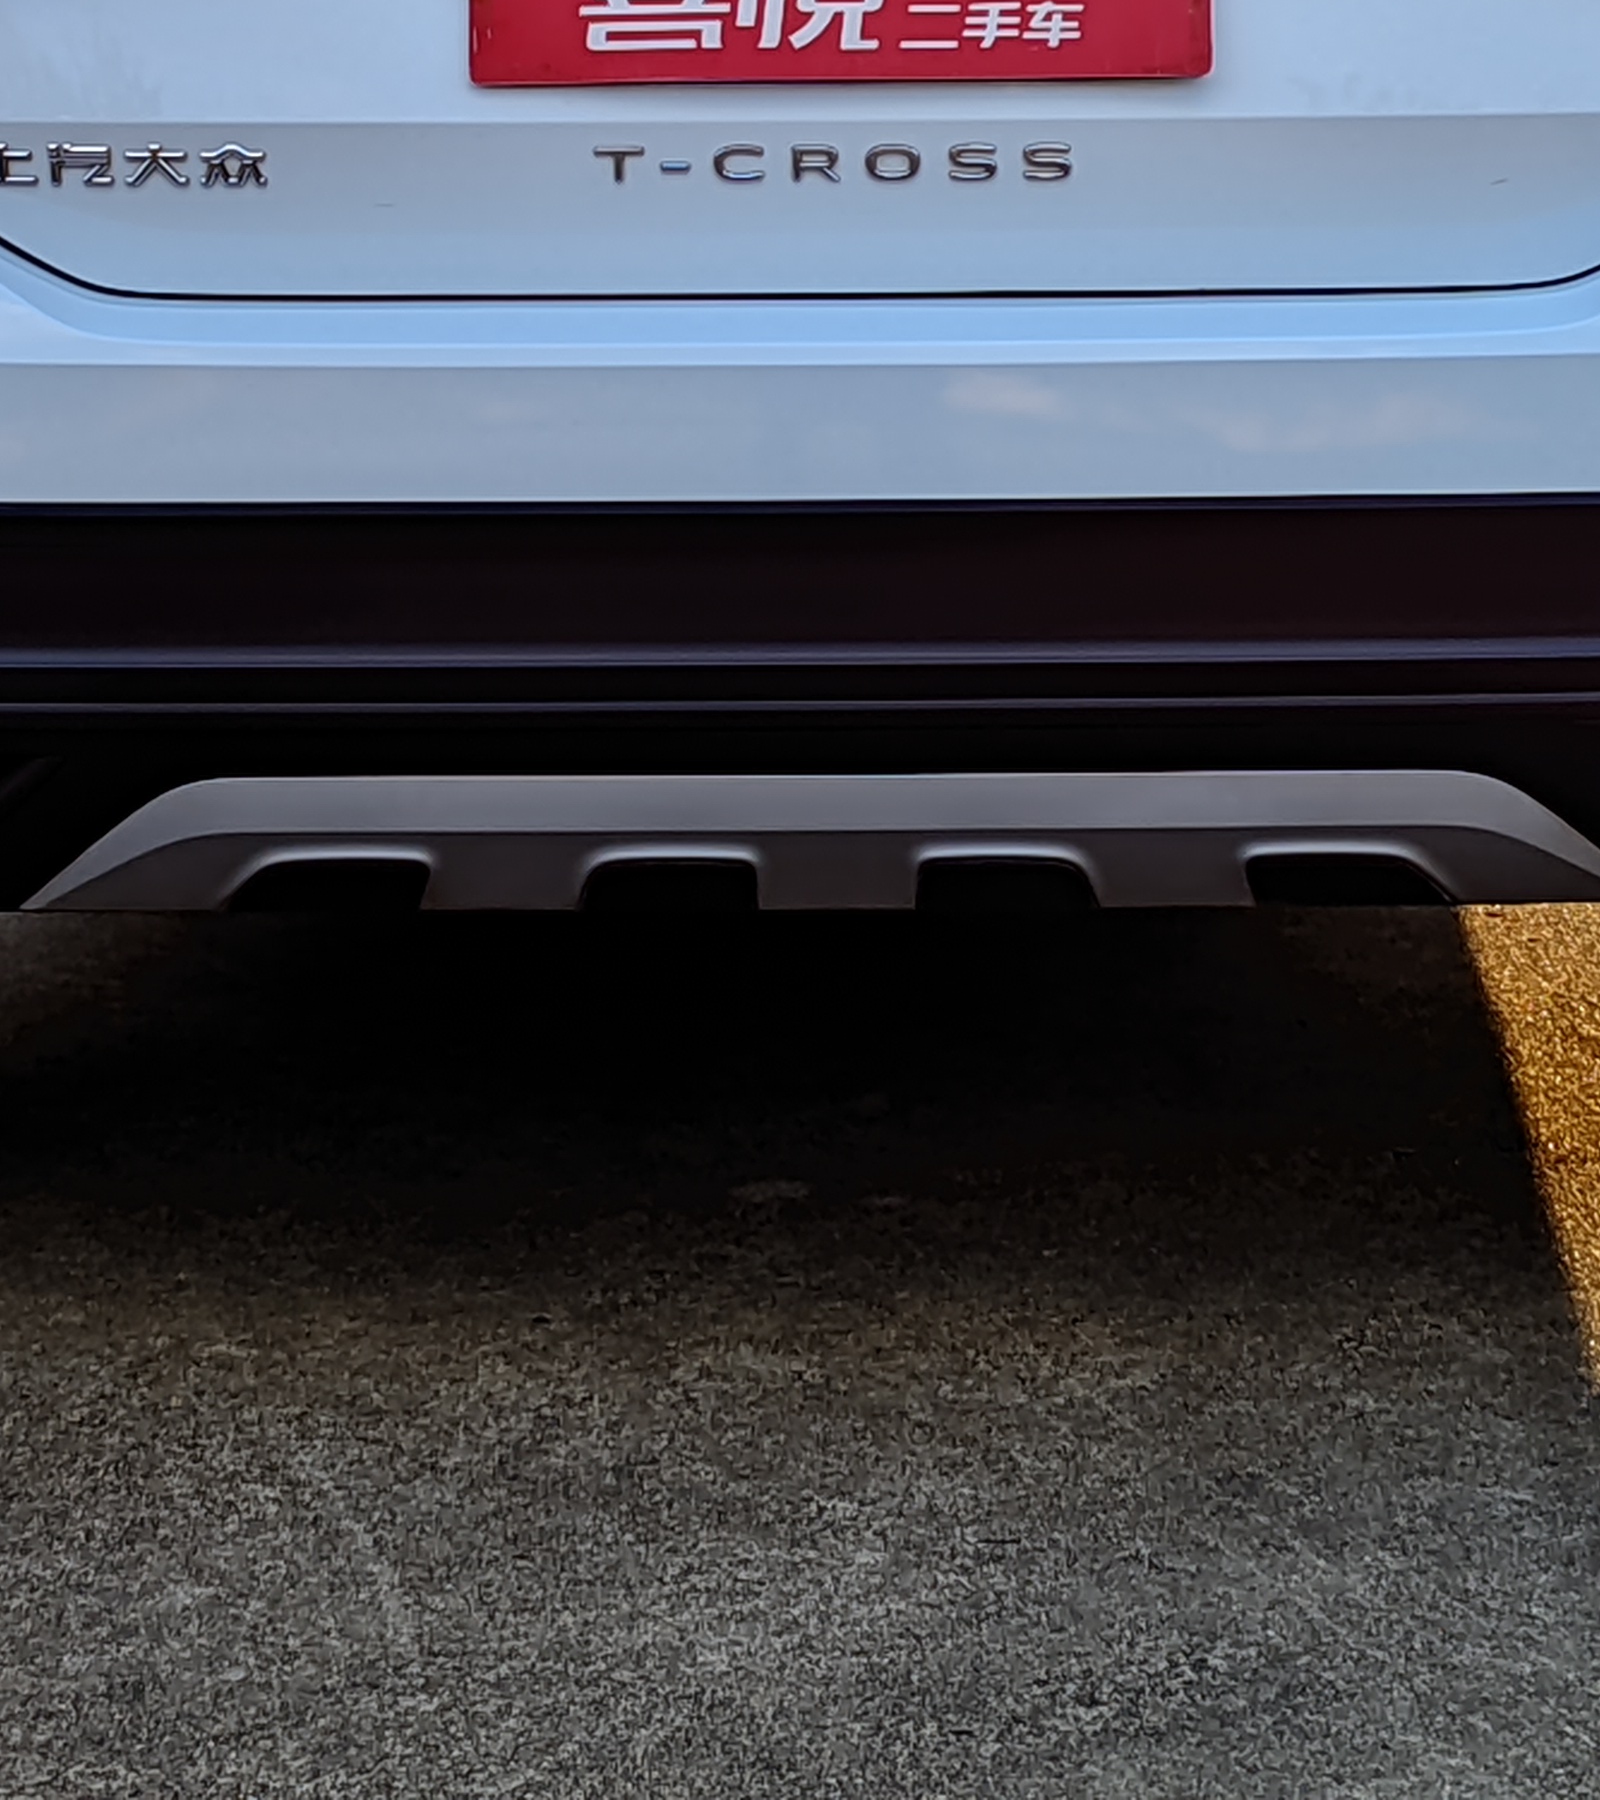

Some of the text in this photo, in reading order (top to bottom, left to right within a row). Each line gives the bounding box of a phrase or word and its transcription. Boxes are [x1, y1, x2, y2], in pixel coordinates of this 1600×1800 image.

[900, 1, 1085, 49] 二手车
[593, 141, 1073, 184] T-CROSS
